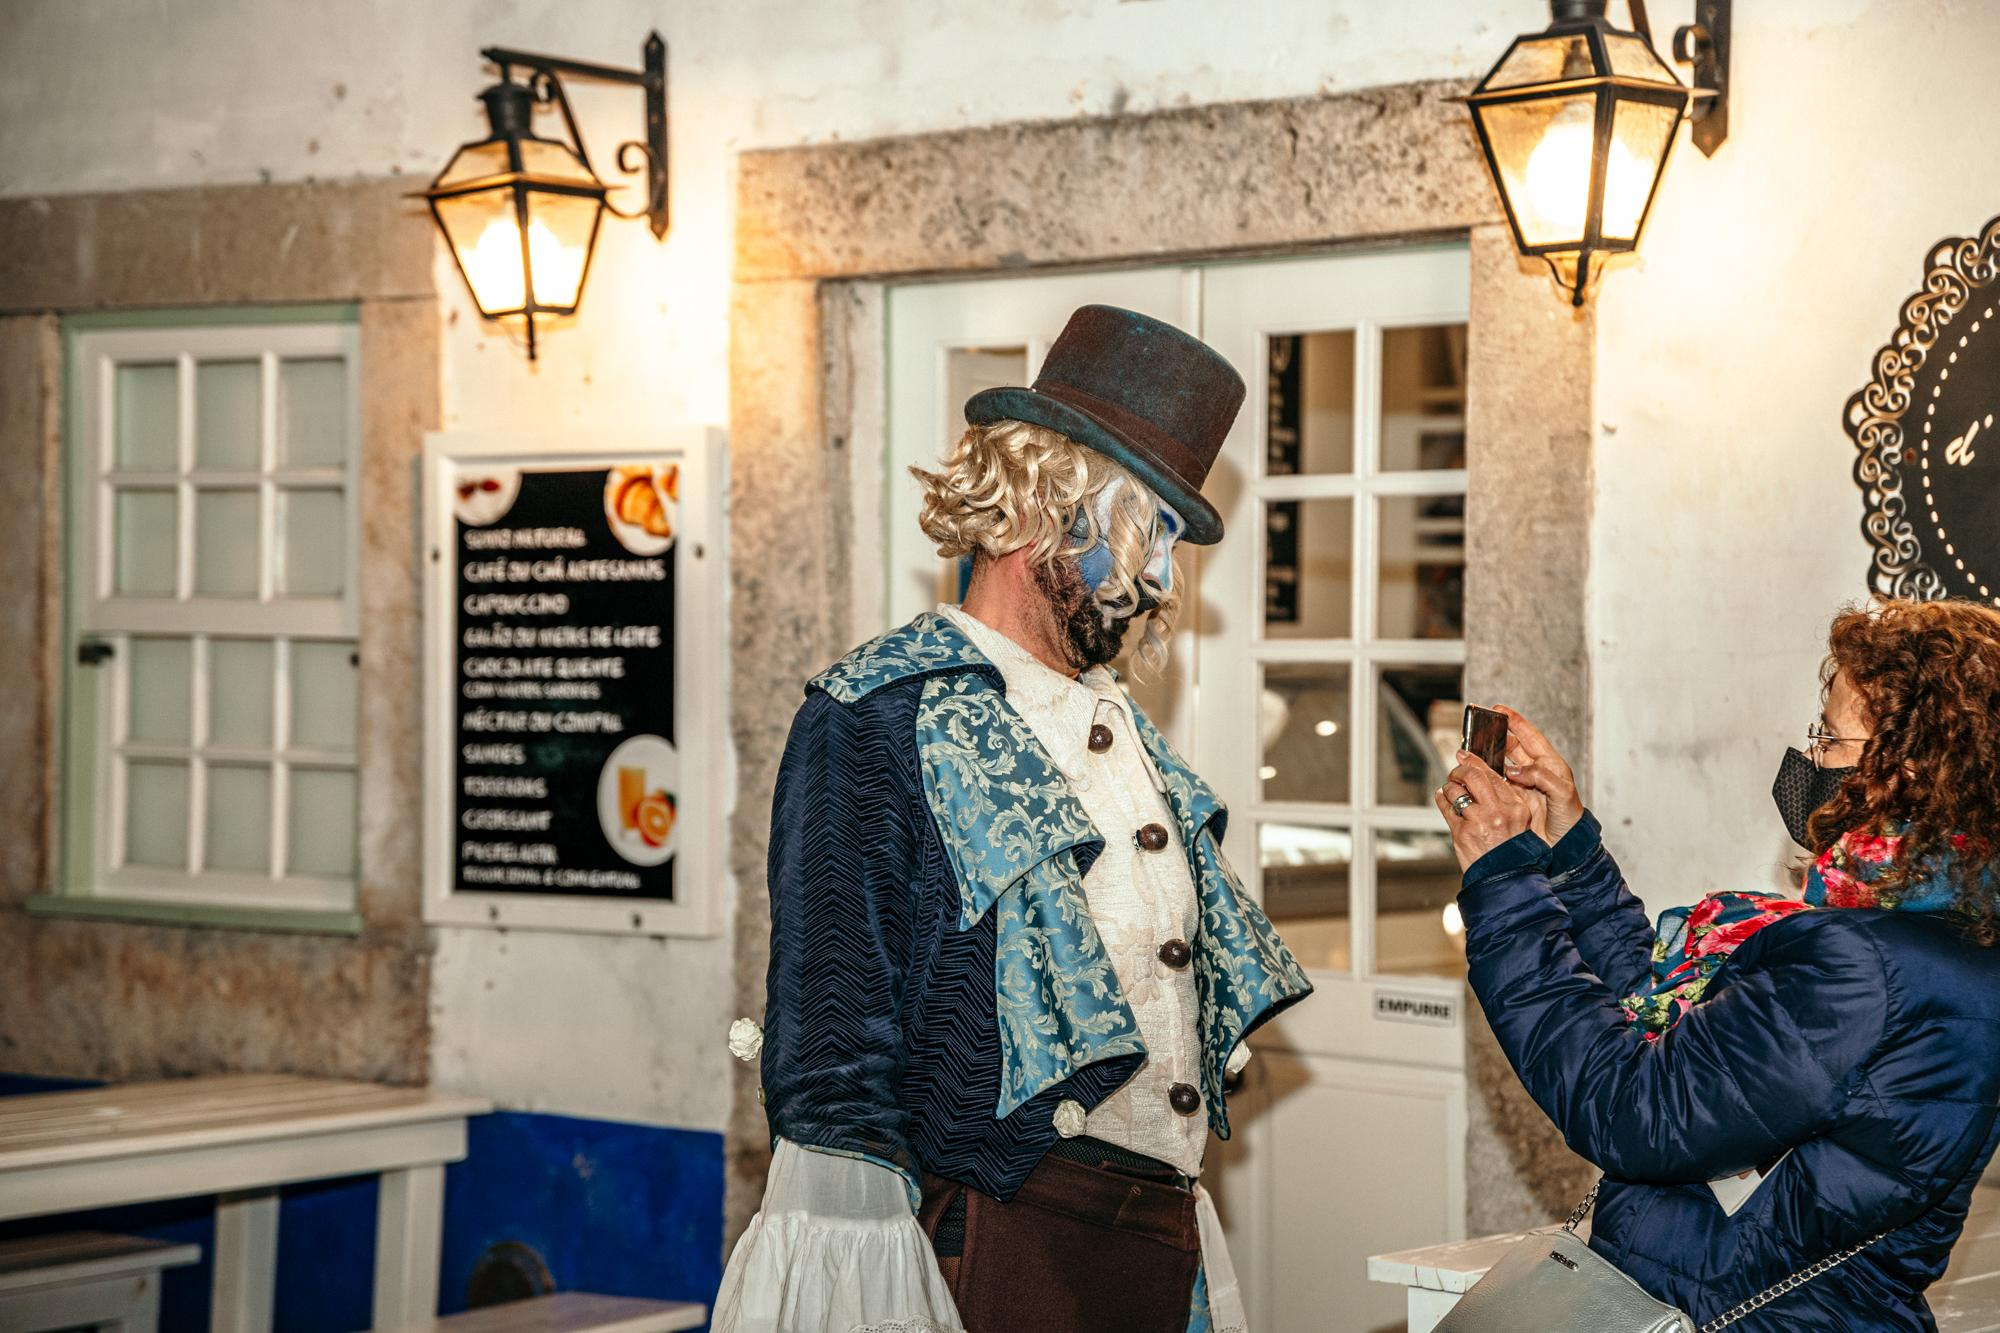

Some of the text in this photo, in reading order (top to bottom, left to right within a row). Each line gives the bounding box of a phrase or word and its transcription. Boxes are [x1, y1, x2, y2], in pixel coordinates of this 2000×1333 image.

[464, 556, 507, 582] CAFÉ
[463, 657, 625, 679] CHOCOLATE QUENTE
[1379, 999, 1450, 1018] EMPURRE
